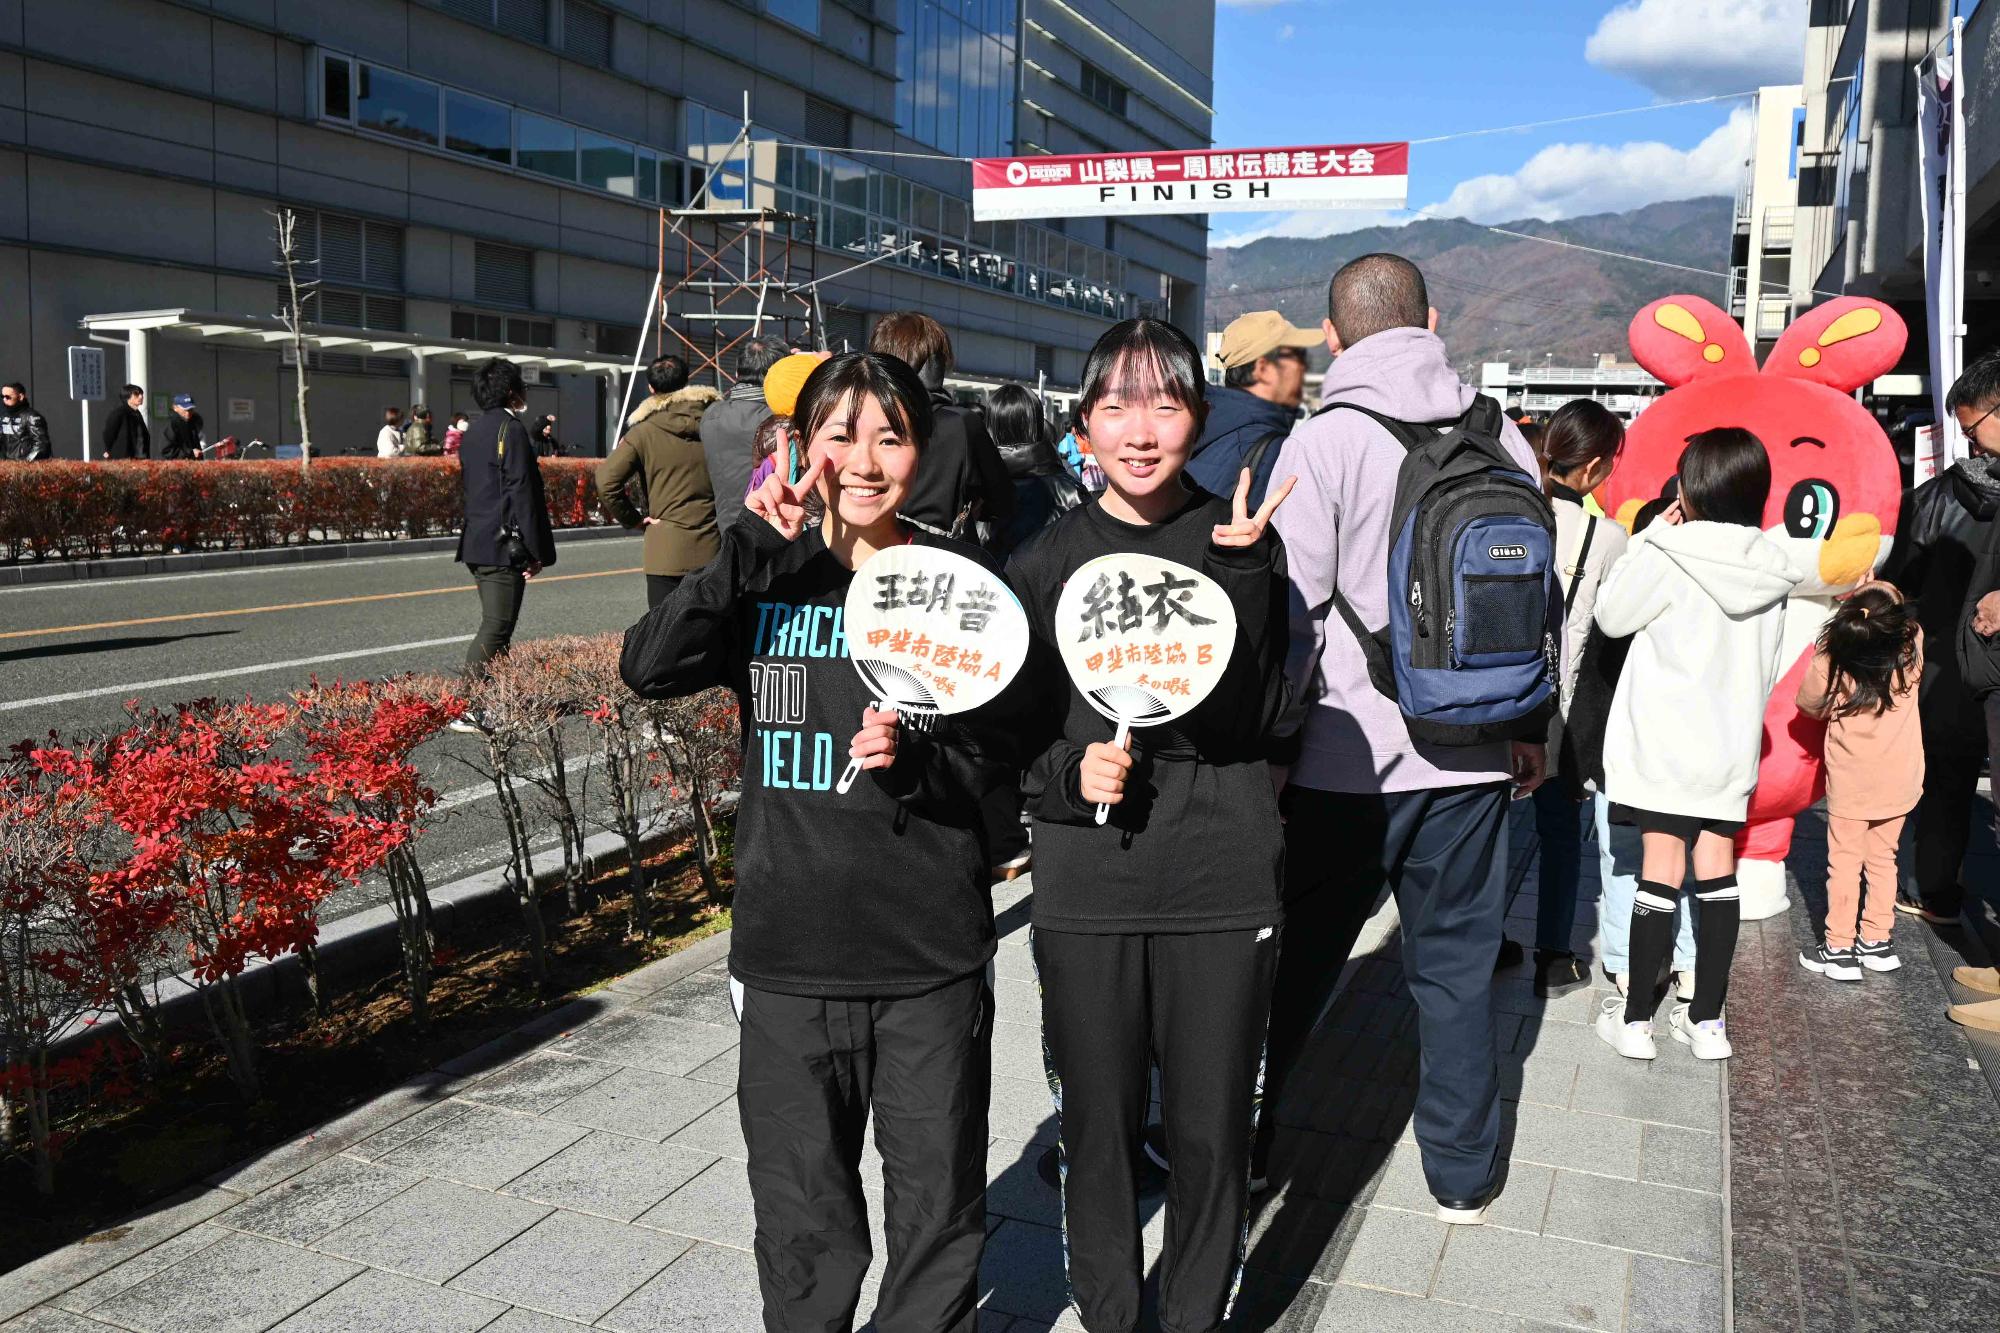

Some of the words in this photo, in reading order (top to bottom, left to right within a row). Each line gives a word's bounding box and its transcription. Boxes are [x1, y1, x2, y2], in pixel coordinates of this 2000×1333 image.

[1079, 149, 1375, 182] 山梨県一周駅伝競走大会
[1100, 182, 1270, 202] FINISH
[1078, 571, 1217, 642] 結衣
[757, 729, 833, 791] IELD
